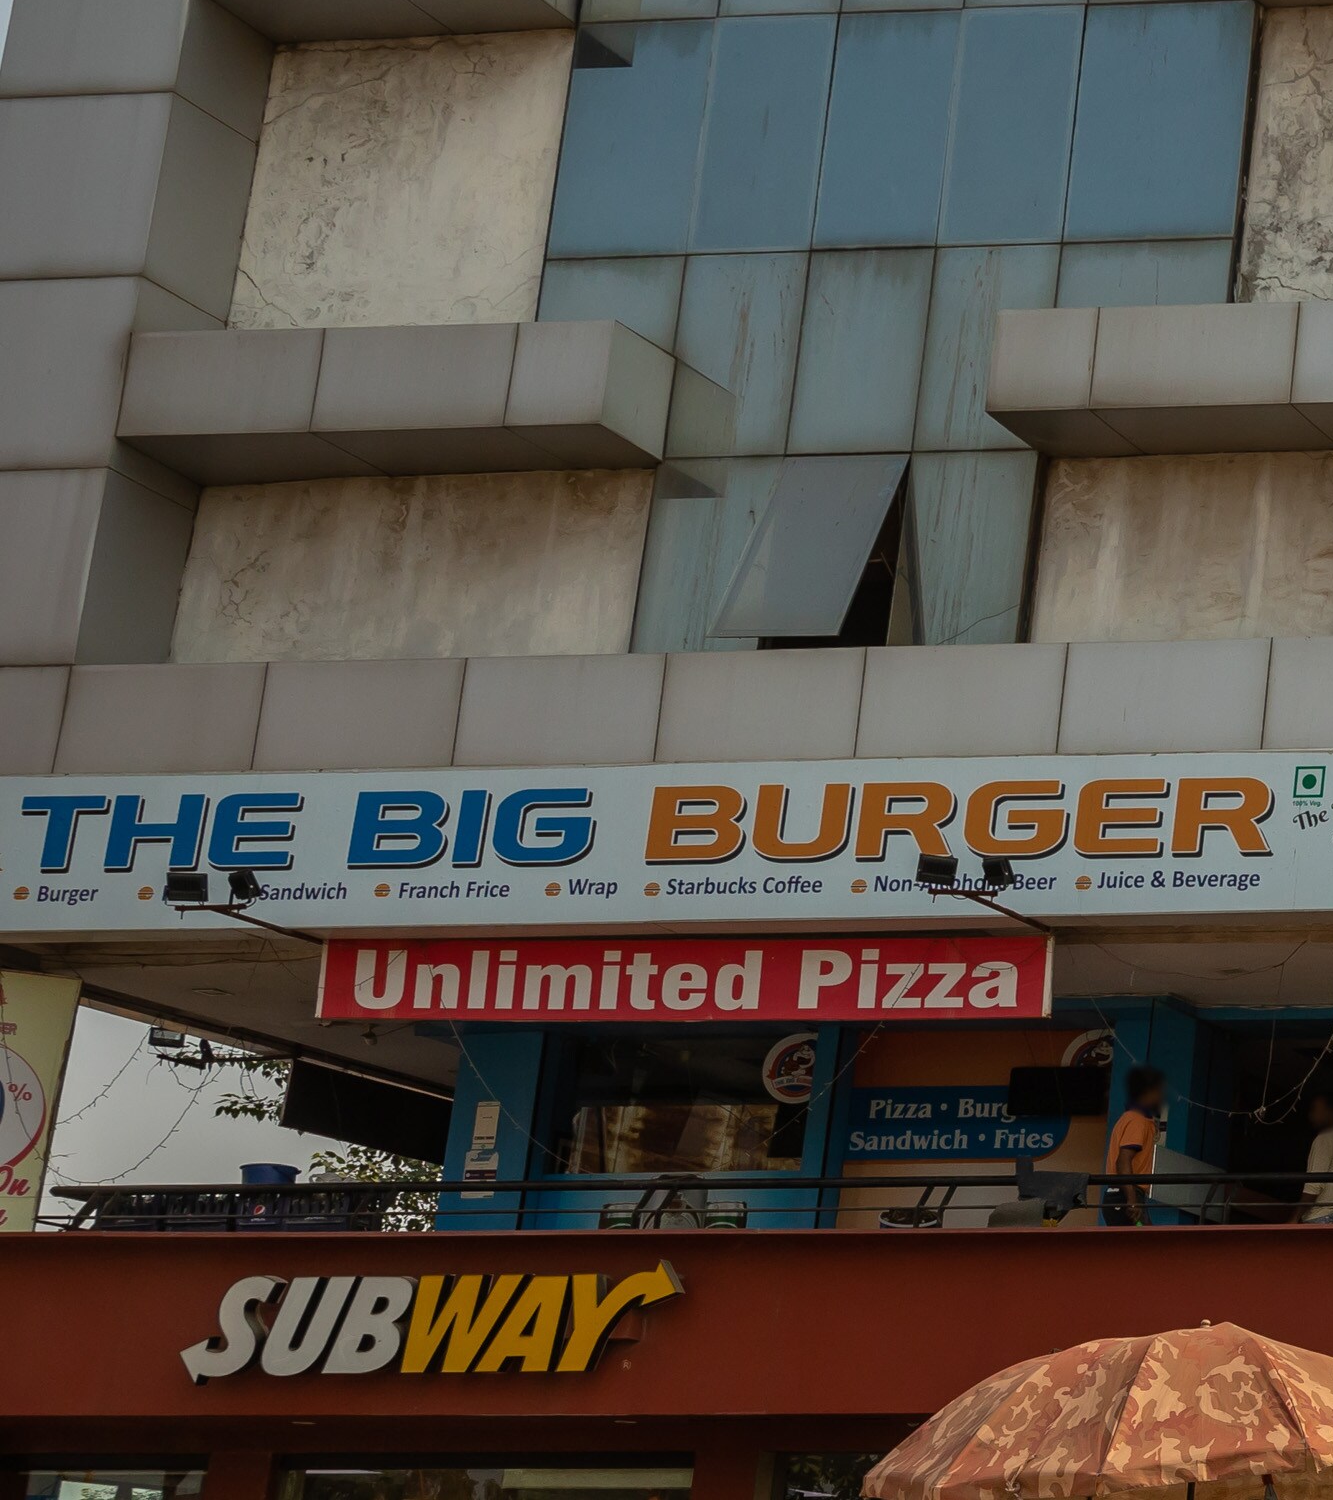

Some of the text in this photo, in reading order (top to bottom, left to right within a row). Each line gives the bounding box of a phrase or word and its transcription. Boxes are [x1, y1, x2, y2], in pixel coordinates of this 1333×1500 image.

[21, 775, 1275, 874] THE BIG BURGER
[1293, 809, 1330, 831] The
[37, 883, 99, 905] Burger
[258, 880, 348, 902] Sandwich
[398, 879, 461, 901] Franch
[465, 878, 511, 901] Frice
[568, 877, 619, 902] Wrap
[666, 875, 757, 898] Starbucks
[761, 873, 824, 898] Coffee
[1012, 873, 1057, 891] Beer
[1097, 870, 1147, 892] Juice
[1152, 871, 1167, 890] &
[1172, 868, 1261, 893] Beverage
[353, 947, 1019, 1012] Unlimited Pizza
[869, 1098, 932, 1120] Pizza
[849, 1128, 1055, 1152] Sandwich Fries
[181, 1260, 685, 1386] SUBWAY
